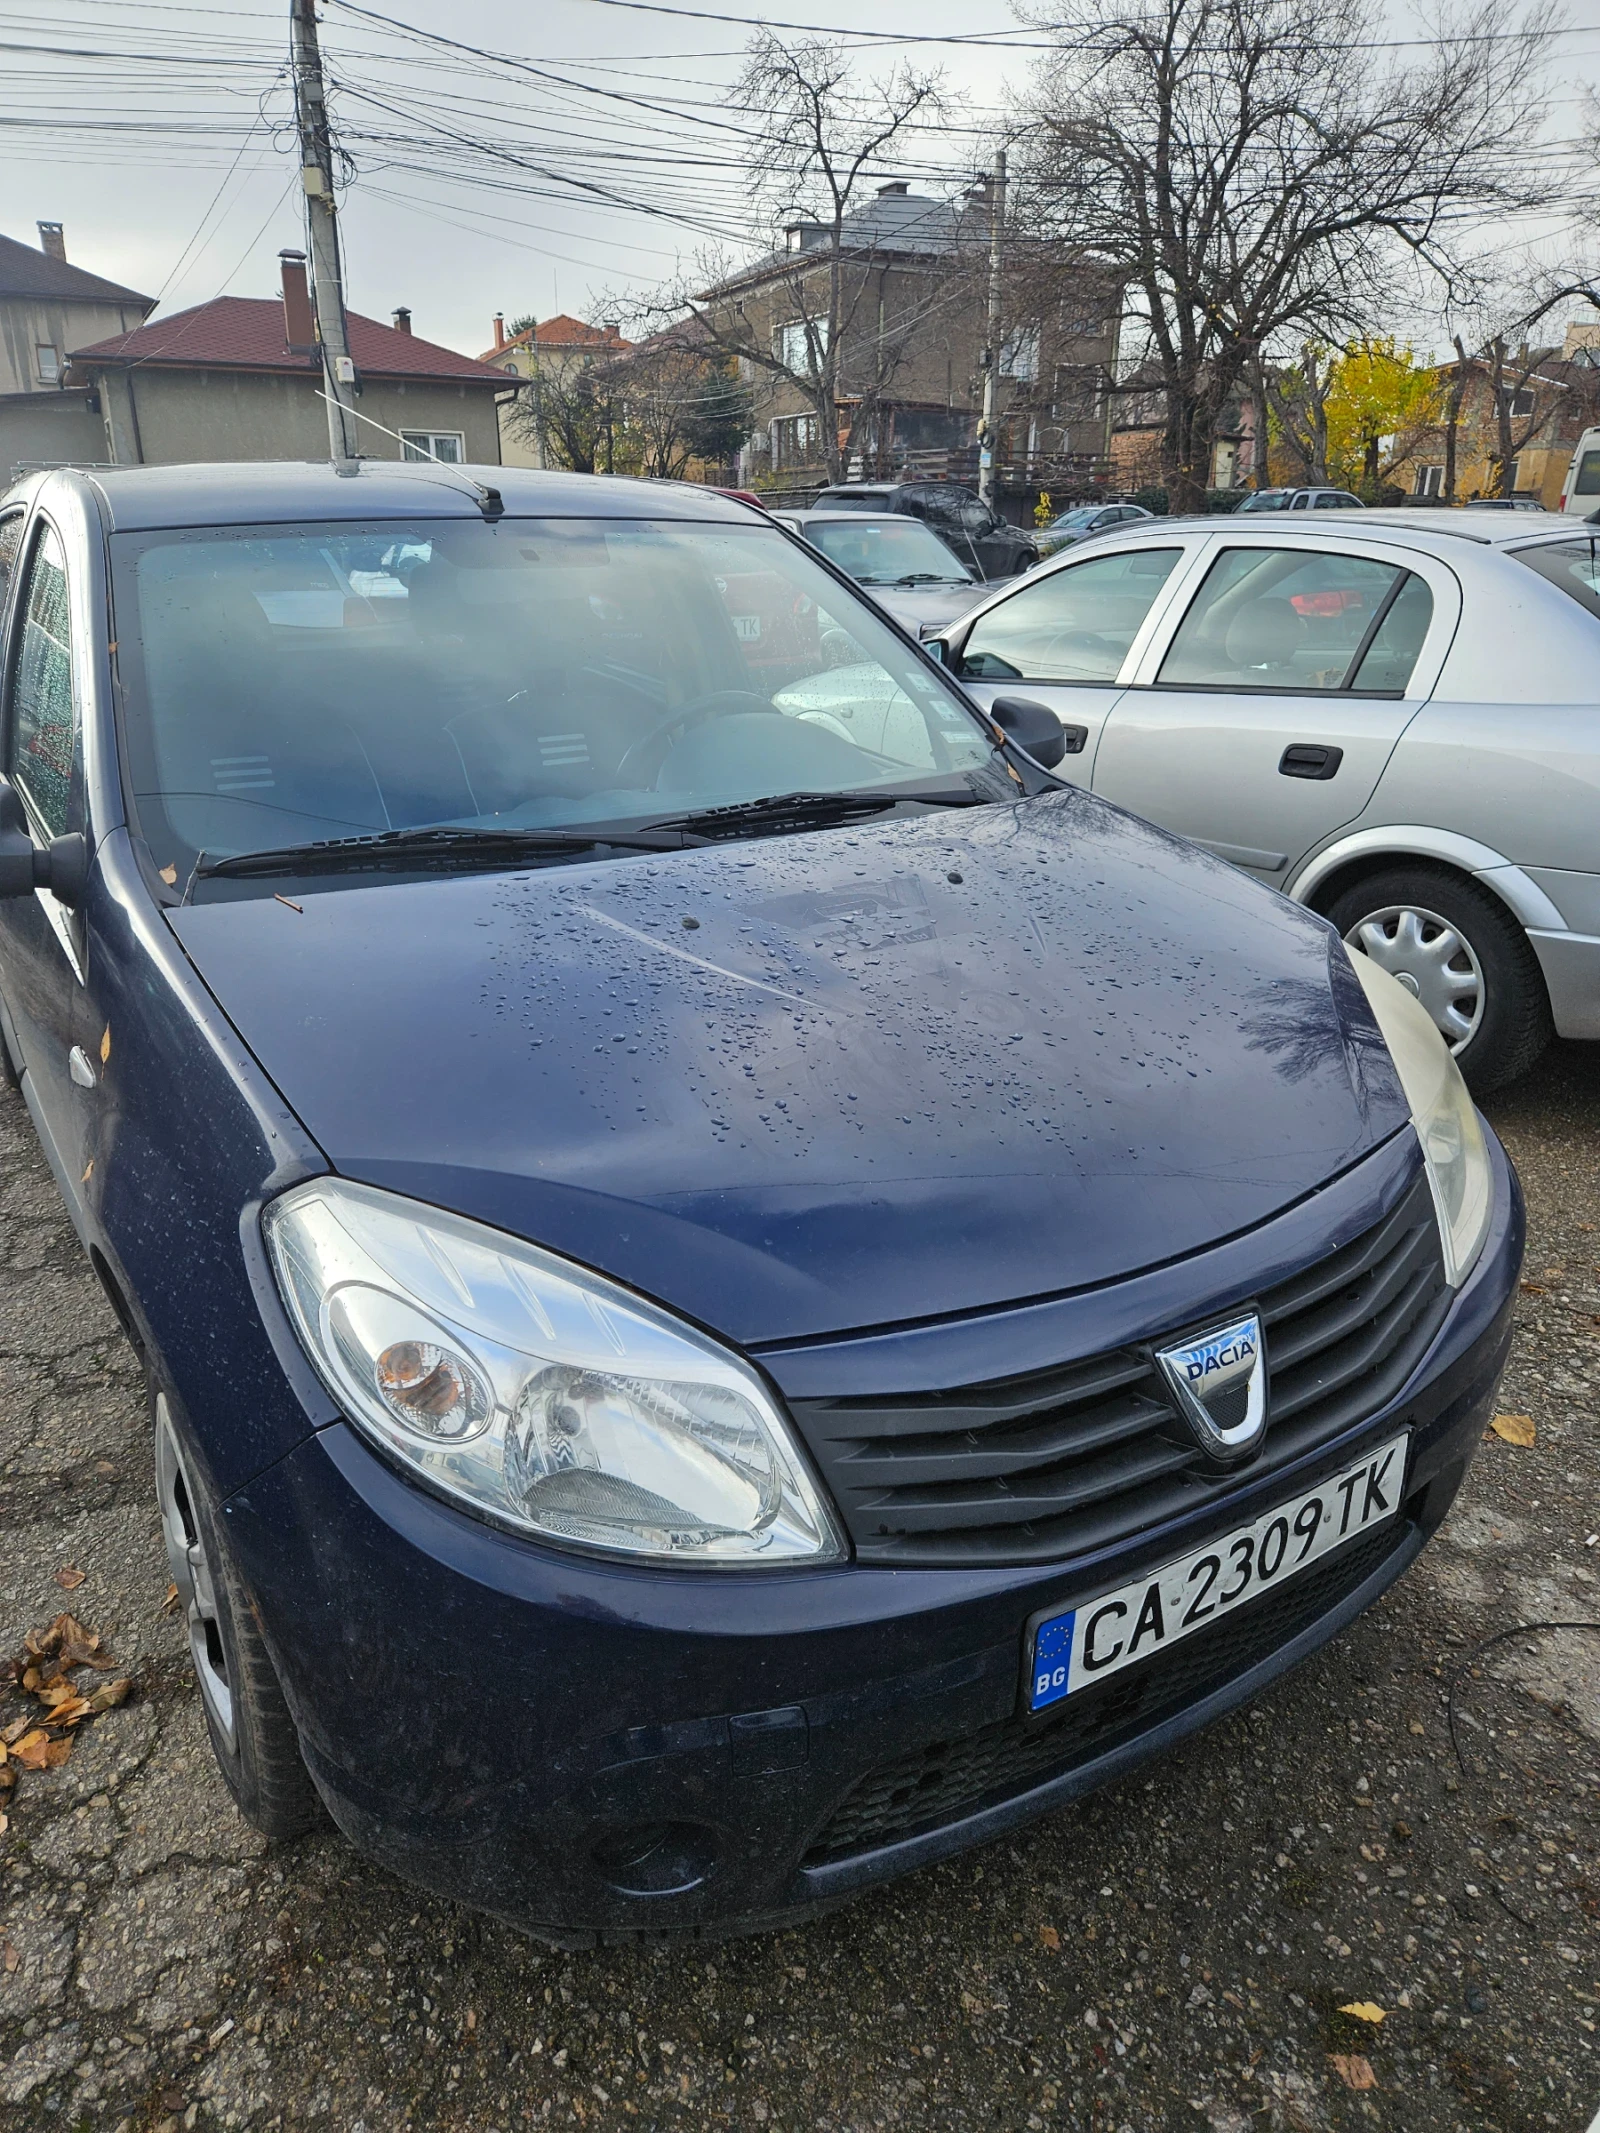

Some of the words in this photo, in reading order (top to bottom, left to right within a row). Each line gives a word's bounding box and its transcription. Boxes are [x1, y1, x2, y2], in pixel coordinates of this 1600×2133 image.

[740, 618, 757, 635] TK
[1185, 1341, 1254, 1381] DACIA
[1082, 1581, 1165, 1672] CA
[1181, 1497, 1324, 1628] 2309
[1337, 1447, 1397, 1536] TK
[1036, 1666, 1066, 1696] BG
